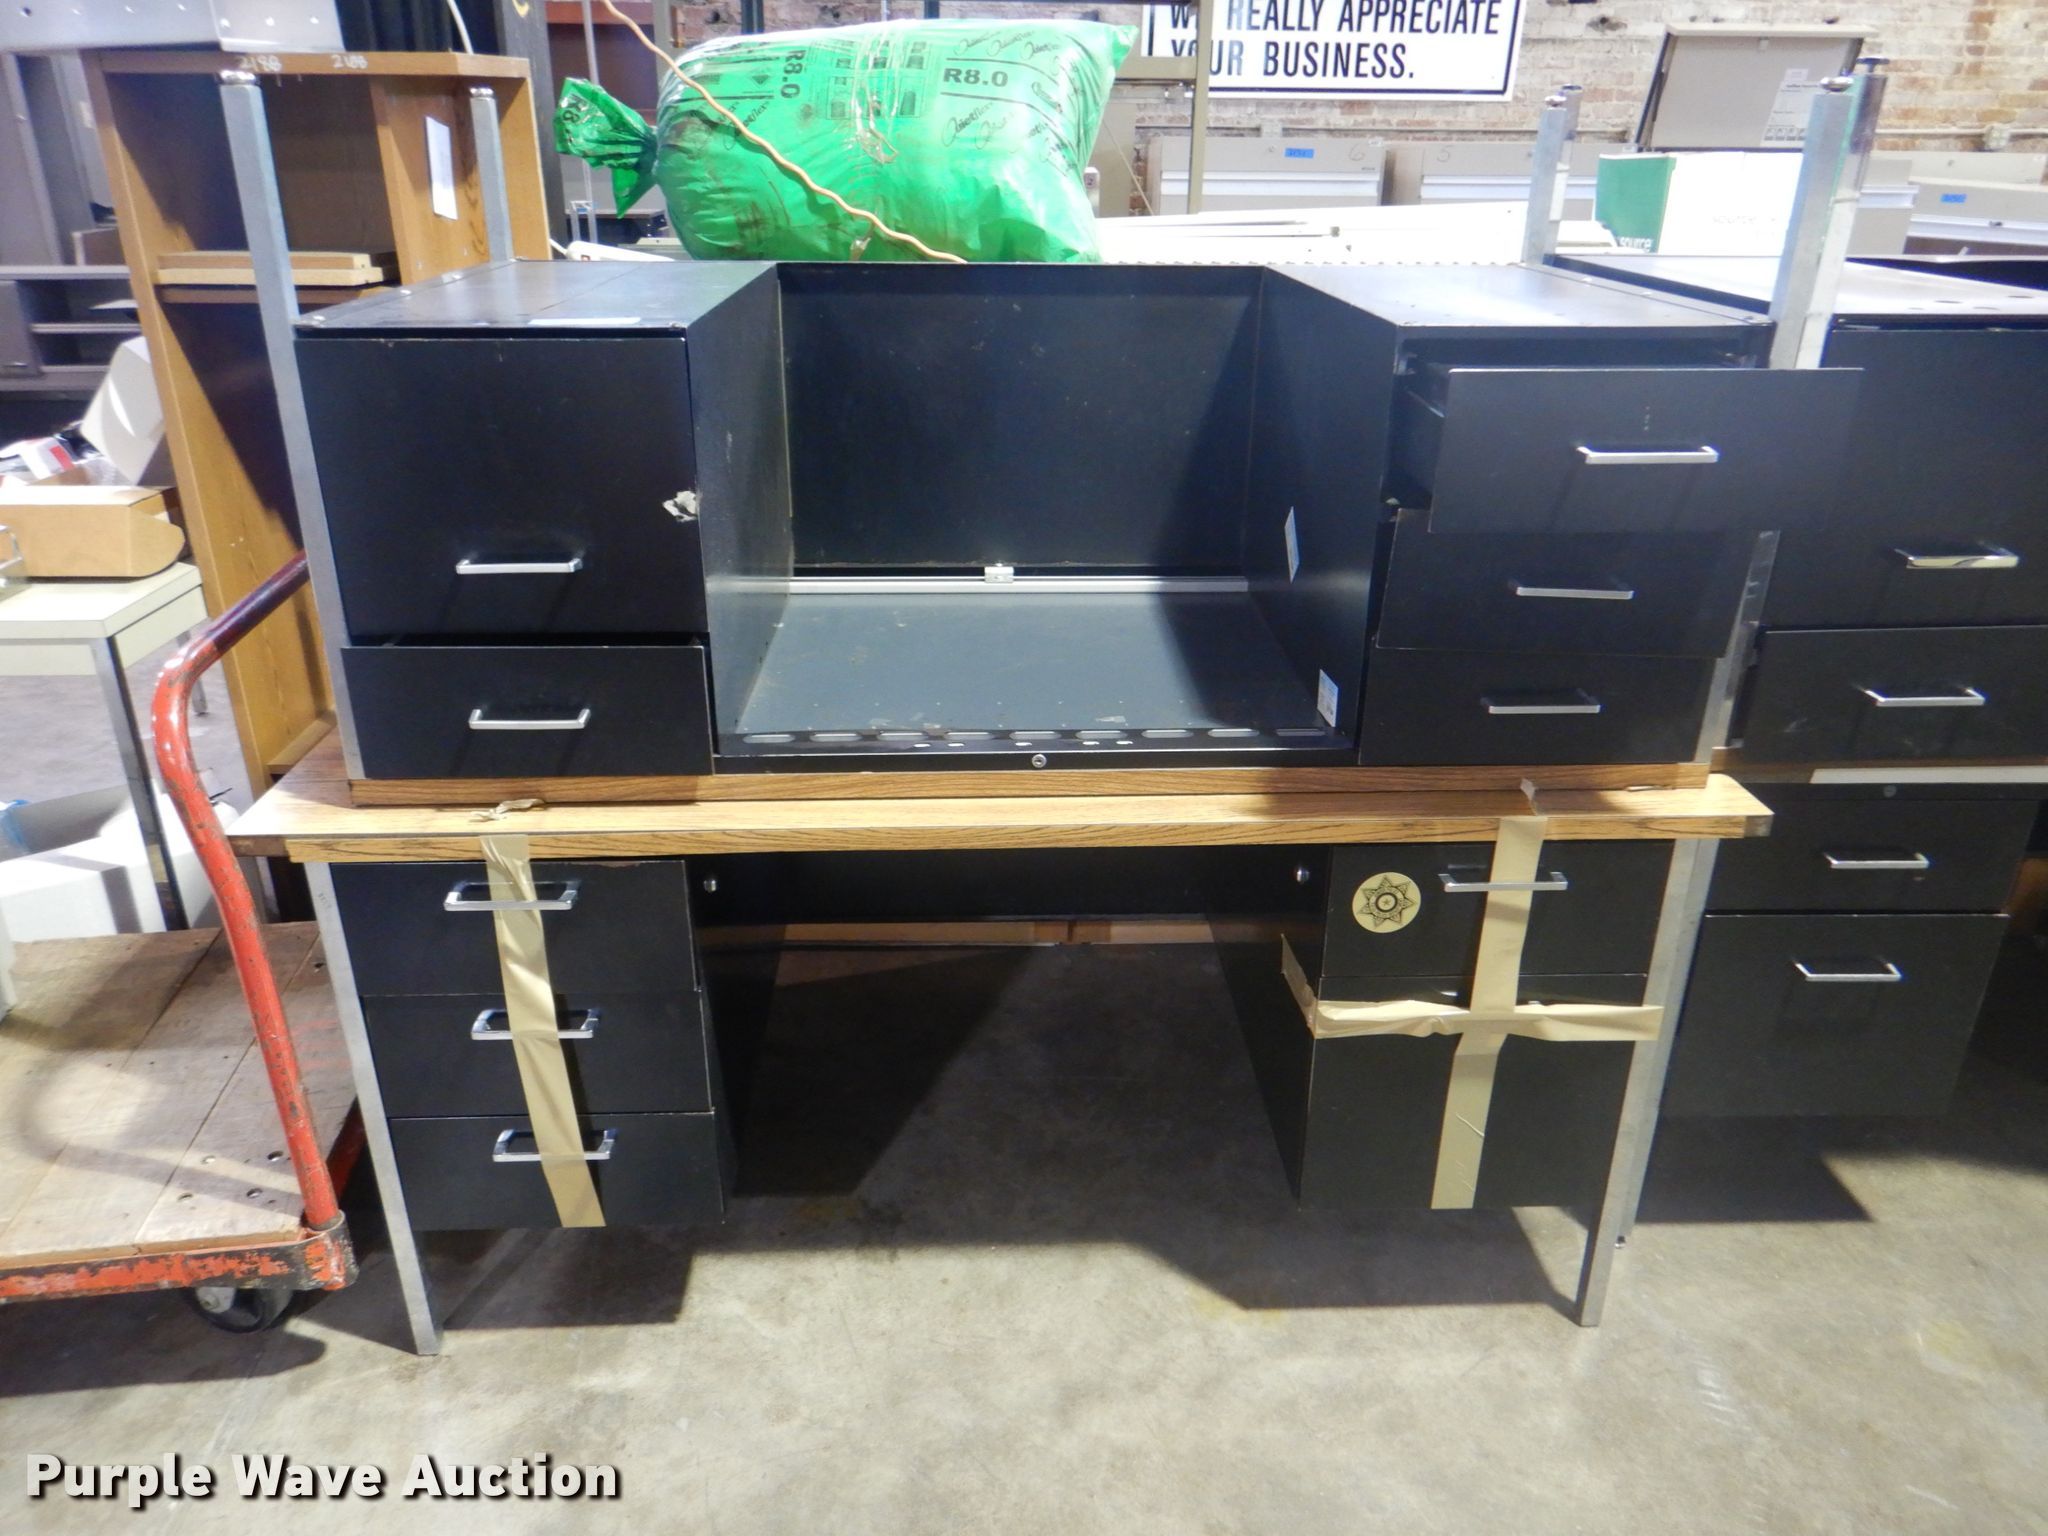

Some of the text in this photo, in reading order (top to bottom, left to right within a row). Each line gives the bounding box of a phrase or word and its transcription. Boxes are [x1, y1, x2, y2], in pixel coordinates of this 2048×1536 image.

[1227, 0, 1323, 31] REALLY
[1337, 0, 1499, 34] APPRECIATE
[780, 49, 806, 99] R8.0
[943, 68, 1009, 88] R8.0
[1263, 41, 1414, 79] BUSINESS.
